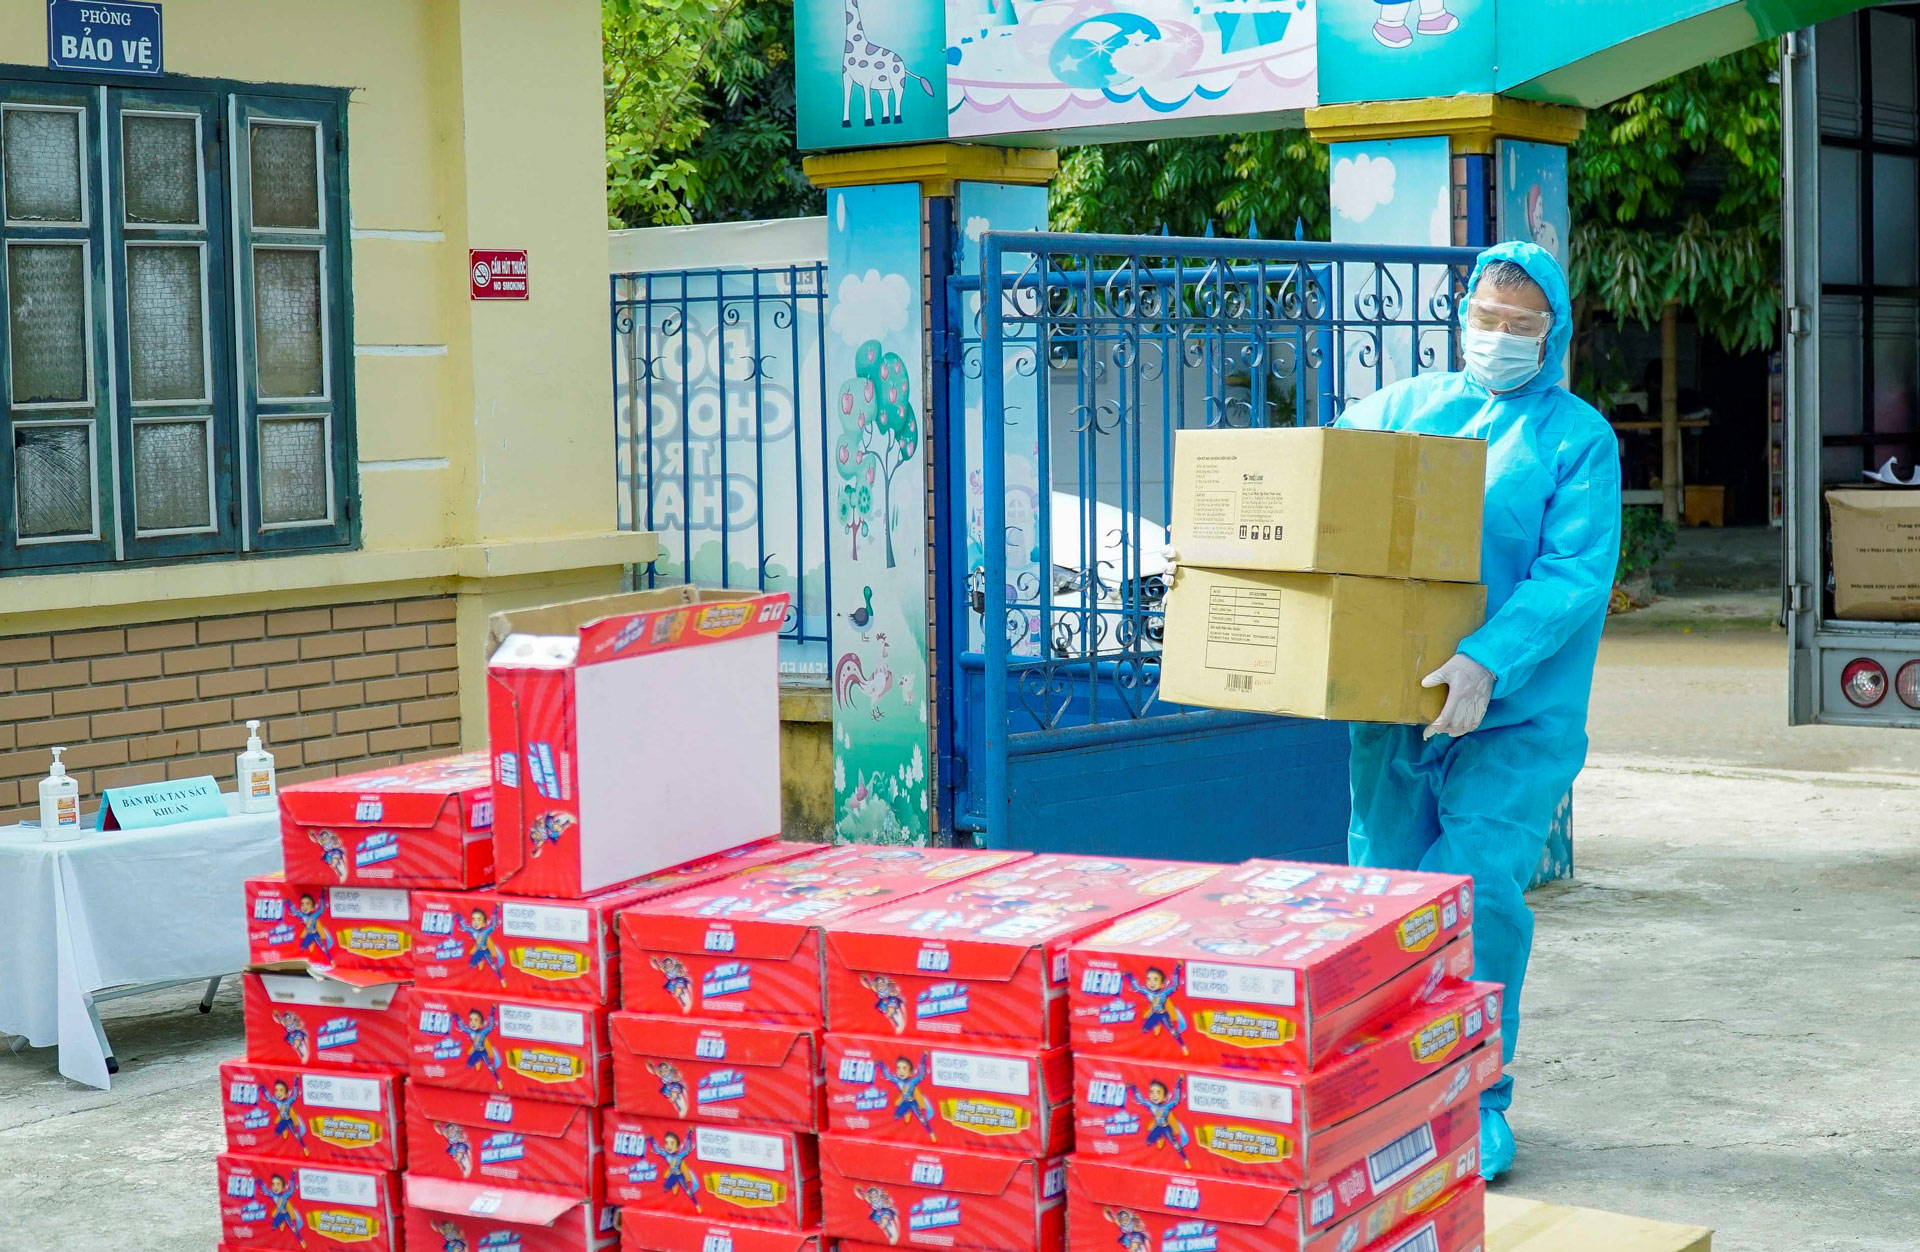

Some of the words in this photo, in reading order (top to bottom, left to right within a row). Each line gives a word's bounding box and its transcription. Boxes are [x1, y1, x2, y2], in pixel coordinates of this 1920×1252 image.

[81, 7, 131, 26] PHÒNG
[62, 27, 113, 61] BẢO
[122, 37, 152, 69] VỆ
[491, 256, 501, 274] CẤM
[502, 257, 510, 274] HÚT
[511, 256, 526, 274] THUỐC
[494, 282, 501, 290] NO
[502, 282, 525, 290] SMOKING
[528, 753, 544, 784] JUICY
[537, 742, 554, 774] DRINK
[500, 752, 519, 788] HERO
[166, 790, 187, 800] TAY
[188, 786, 208, 798] SÁT
[544, 774, 560, 798] MILK
[356, 802, 383, 821] HERO
[255, 899, 284, 919] HERO
[421, 911, 453, 934] HERO
[704, 931, 735, 951] HERO
[917, 950, 950, 972] HERO
[929, 983, 957, 1000] JUICY
[1082, 969, 1122, 995] HERO
[916, 1001, 938, 1017] MILK
[939, 996, 969, 1012] DRINK
[420, 1010, 451, 1034] HERO
[696, 1038, 725, 1059] HERO
[710, 1070, 734, 1084] JUICY
[839, 1057, 875, 1083] HERO
[231, 1083, 258, 1104] HERO
[698, 1089, 718, 1103] MILK
[718, 1084, 744, 1099] DRINK
[1088, 1079, 1126, 1107] HERO
[485, 1102, 512, 1122] HERO
[614, 1133, 646, 1156] HERO
[912, 1163, 944, 1186] HERO
[228, 1176, 255, 1197] HERO
[922, 1196, 948, 1212] JUICY
[1165, 1186, 1199, 1209] HERO
[1311, 1190, 1334, 1226] HERO
[910, 1214, 932, 1230] MILK
[932, 1210, 960, 1226] DRINK
